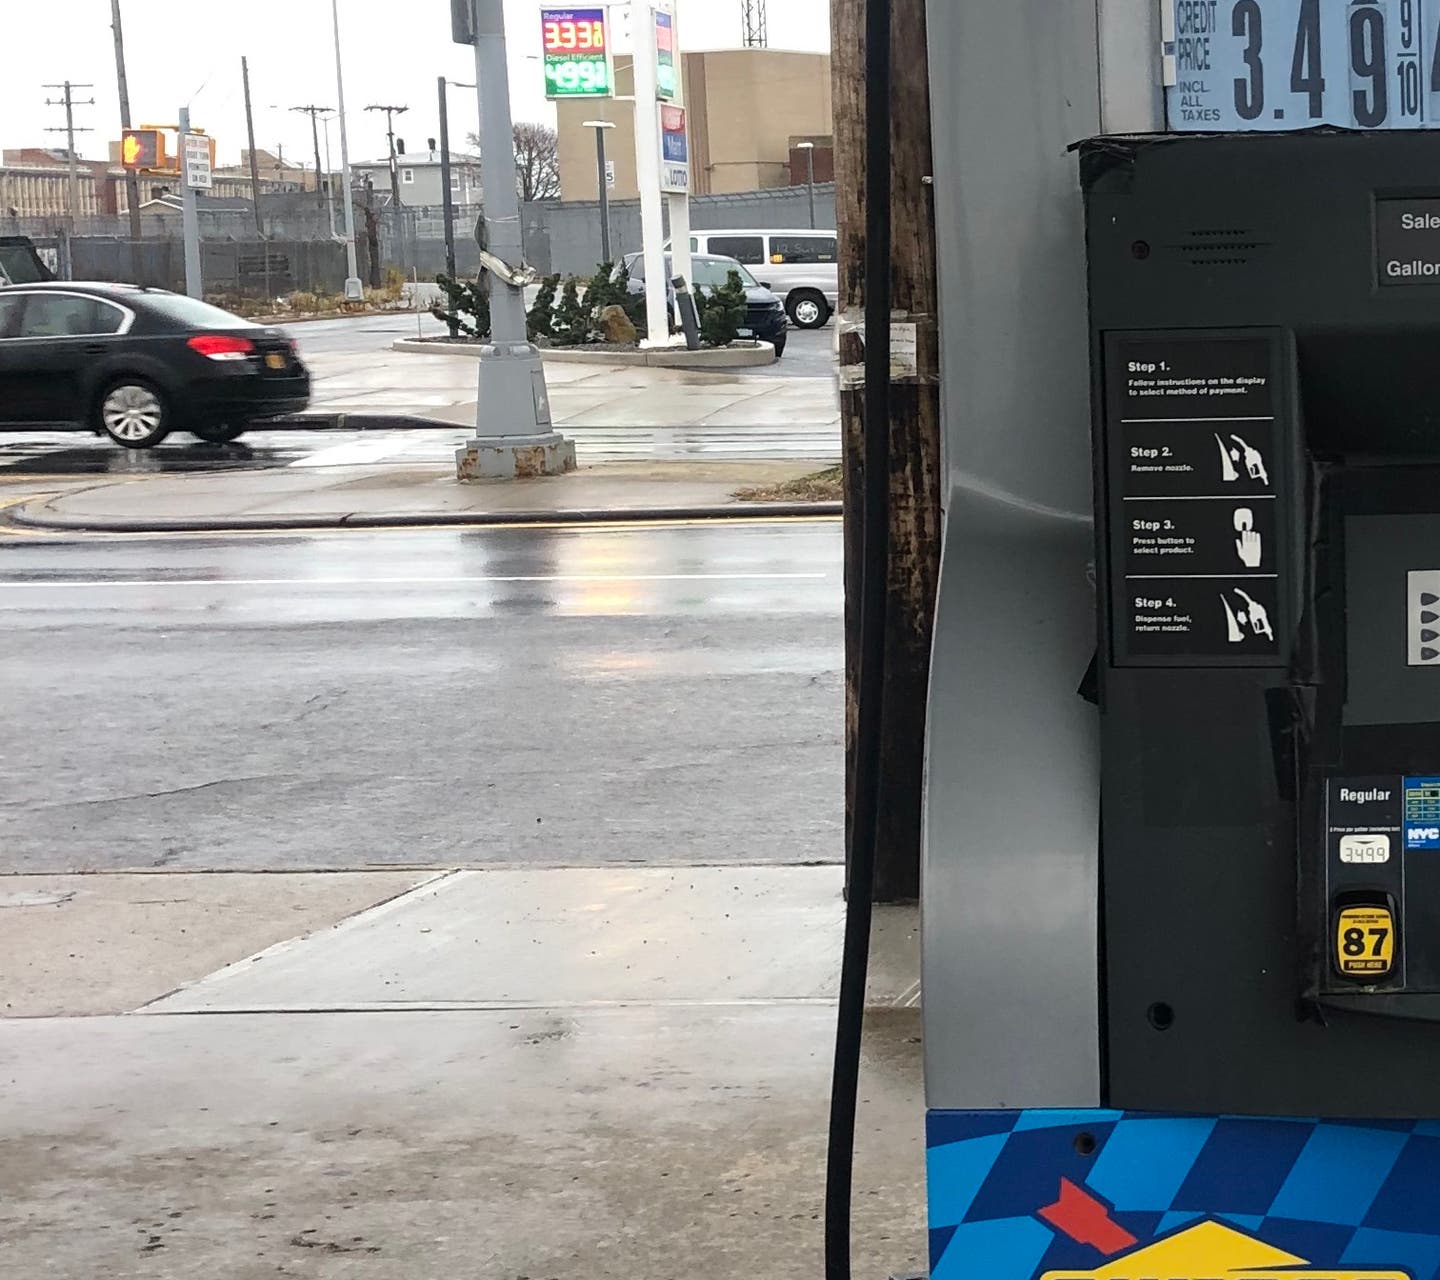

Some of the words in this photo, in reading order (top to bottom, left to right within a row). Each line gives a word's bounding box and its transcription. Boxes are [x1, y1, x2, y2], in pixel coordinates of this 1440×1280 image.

[544, 11, 574, 21] Regular
[1177, 0, 1217, 33] CREDIT
[1178, 38, 1211, 71] PRICE
[1180, 95, 1203, 107] ALL
[1182, 108, 1221, 122] TAXES
[1401, 213, 1440, 229] Sale
[1128, 361, 1156, 373] Step
[1159, 361, 1171, 371] 1.
[1156, 377, 1206, 386] instructions
[1220, 377, 1234, 385] the
[1236, 376, 1266, 386] display
[1139, 388, 1164, 396] select
[1166, 387, 1197, 395] method
[1130, 447, 1158, 459] Step
[1161, 446, 1173, 457] 2.
[1132, 519, 1160, 531] Step
[1163, 519, 1175, 530] 3.
[1133, 537, 1156, 545] Press
[1157, 537, 1184, 545] button
[1185, 537, 1195, 545] to
[1135, 597, 1162, 609] Step
[1165, 597, 1177, 608] 4.
[1340, 787, 1391, 803] Regular
[1408, 828, 1439, 839] NYC
[1343, 927, 1389, 956] 87
